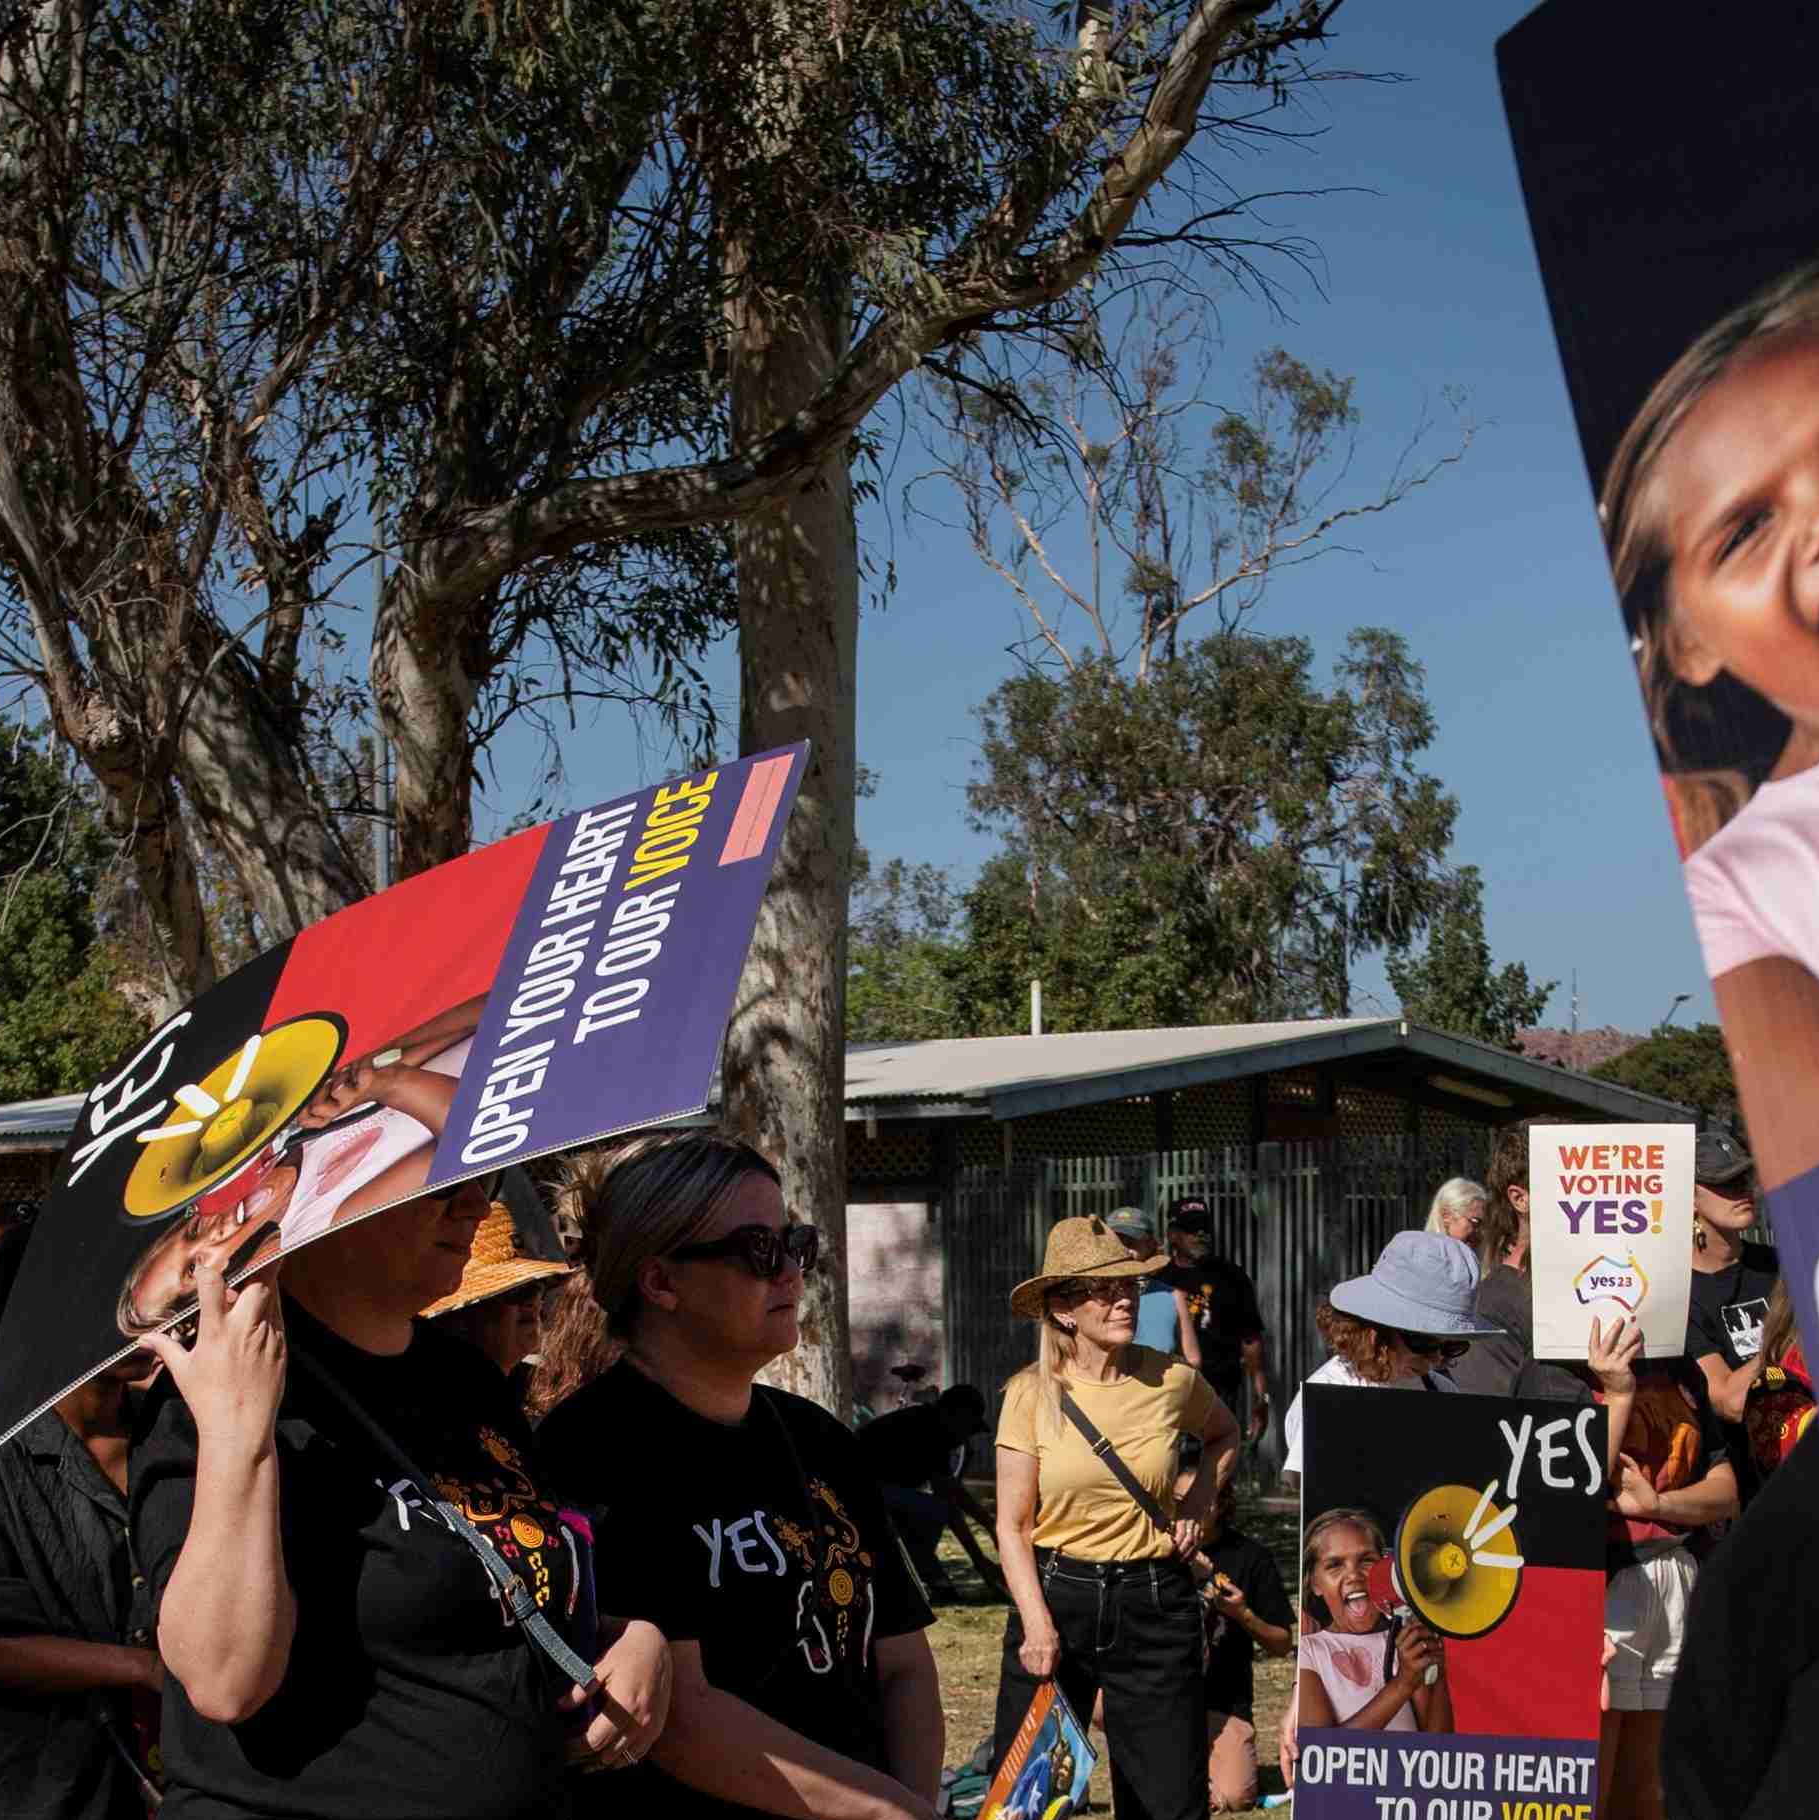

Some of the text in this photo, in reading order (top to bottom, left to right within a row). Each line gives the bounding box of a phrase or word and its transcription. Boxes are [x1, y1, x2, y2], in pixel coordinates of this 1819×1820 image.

[572, 770, 720, 1046] TO OUR VOICE
[460, 801, 638, 1165] OPEN YOUR HEART
[66, 1010, 194, 1189] YES
[1557, 1144, 1666, 1170] WE'RE
[1558, 1174, 1664, 1195] VOTING
[1557, 1199, 1664, 1234] YES!
[1589, 1274, 1634, 1290] yes23
[1497, 1405, 1604, 1501] YES
[691, 1509, 788, 1589] YES
[1300, 1743, 1597, 1796] OPEN YOUR HEART
